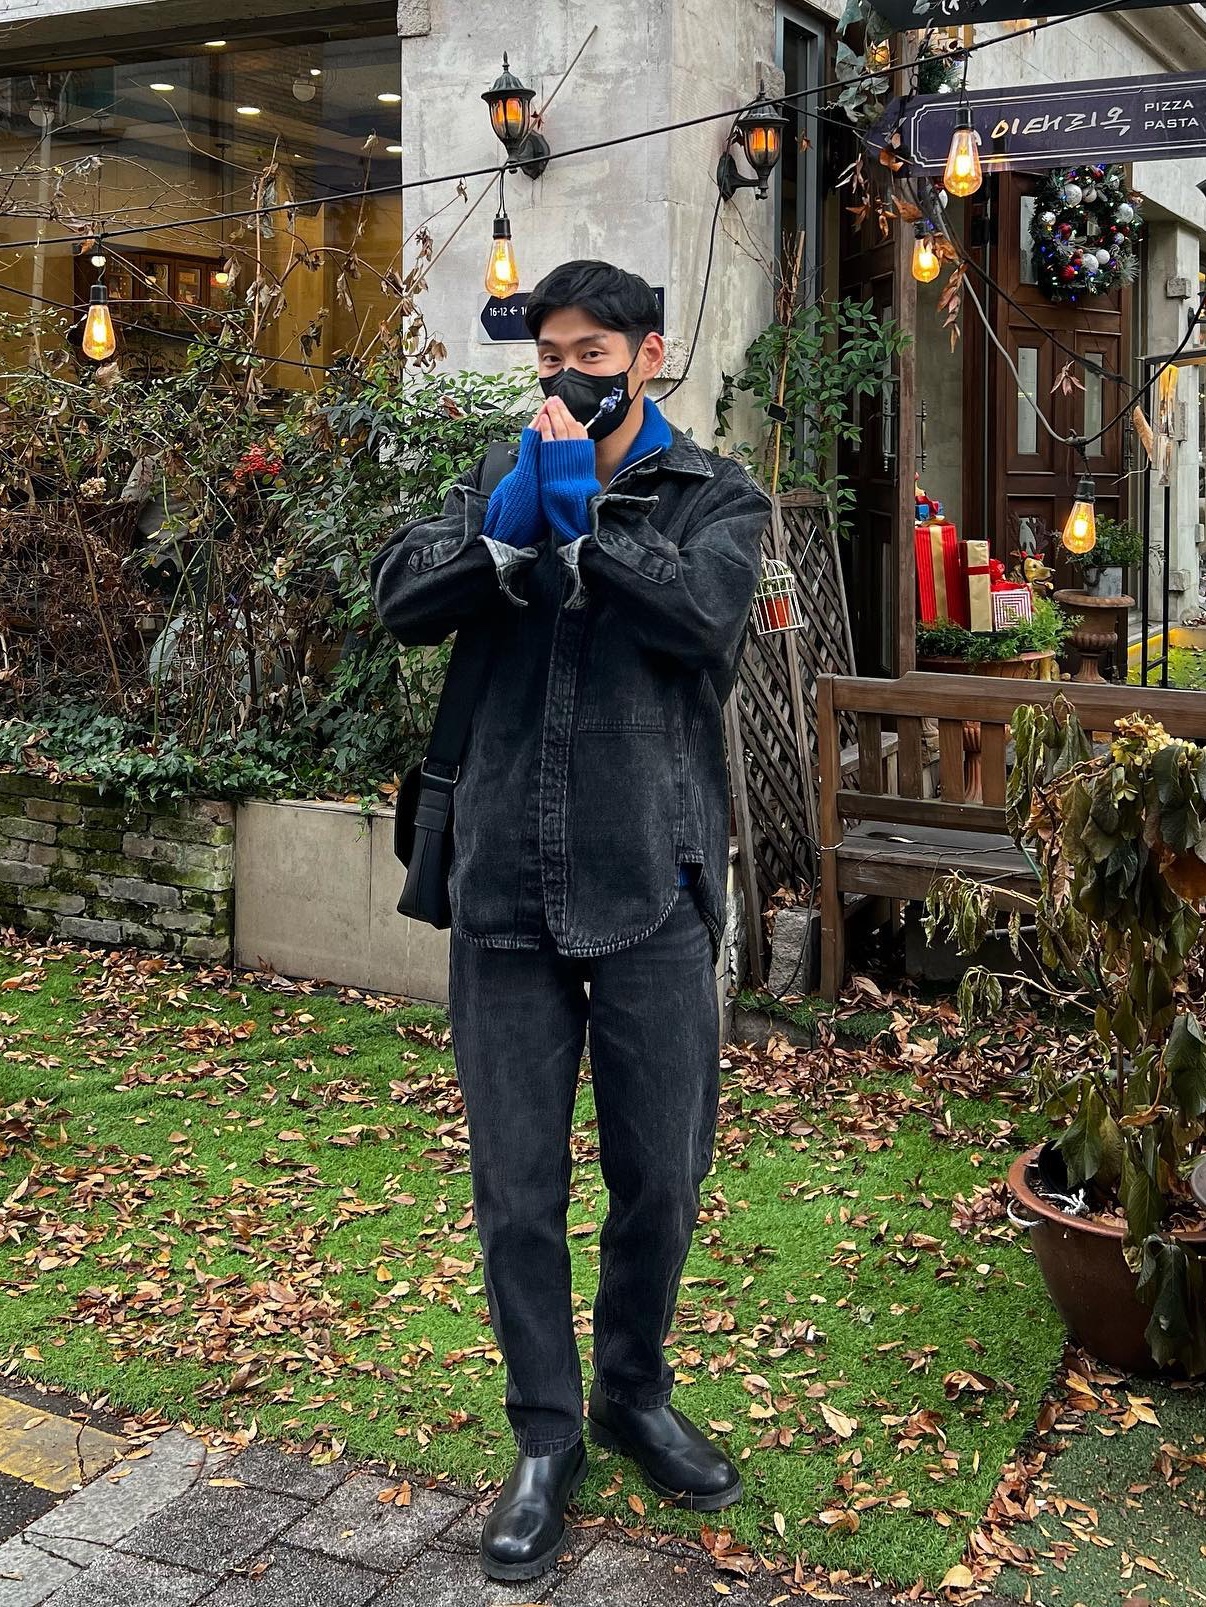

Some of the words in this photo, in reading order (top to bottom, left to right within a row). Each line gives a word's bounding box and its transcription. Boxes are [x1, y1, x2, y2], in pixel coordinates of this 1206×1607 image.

[1144, 99, 1194, 113] PIZZA
[990, 106, 1132, 139] 이태리옥
[1144, 117, 1200, 131] PASTA
[489, 307, 508, 317] 16-12
